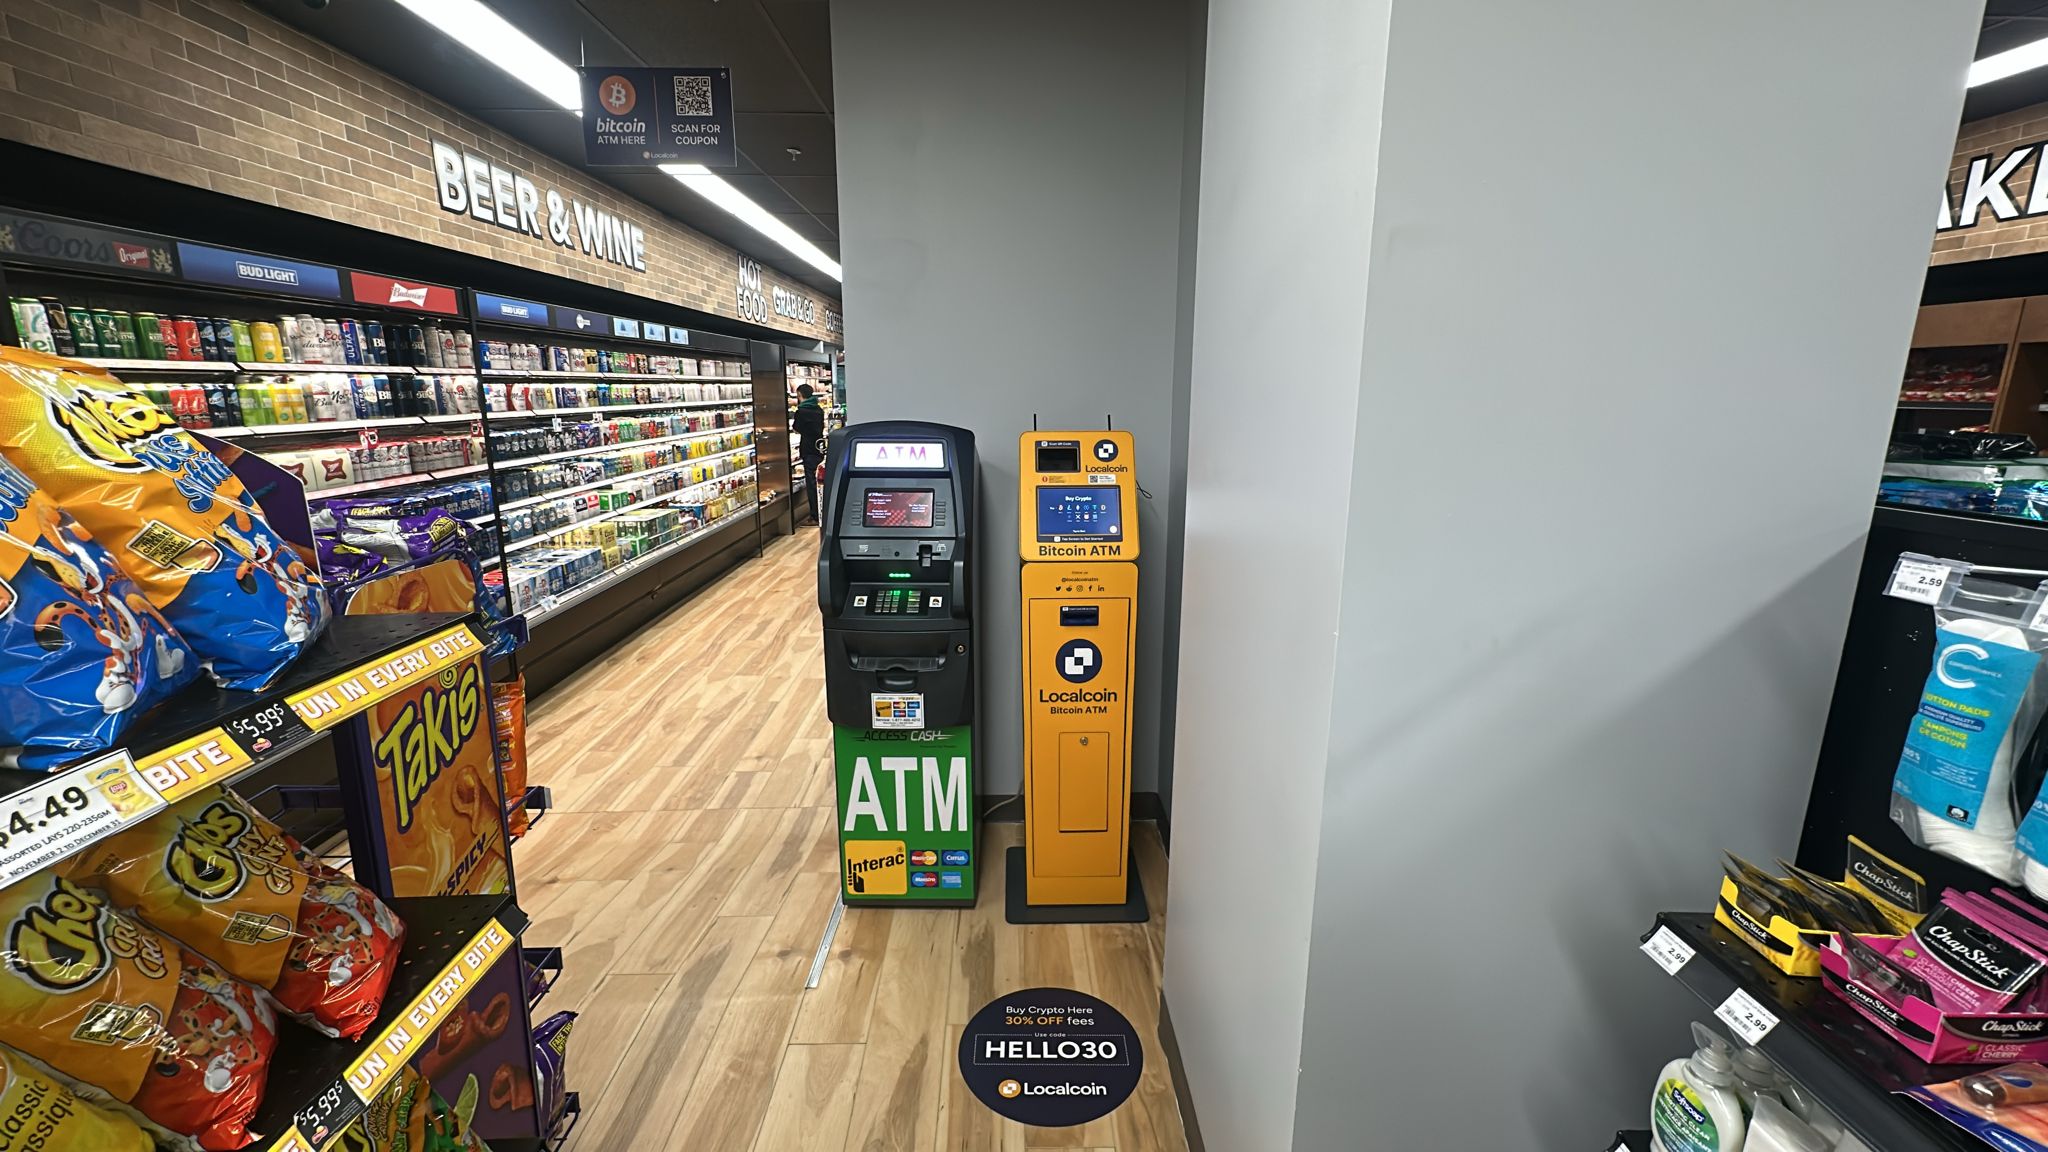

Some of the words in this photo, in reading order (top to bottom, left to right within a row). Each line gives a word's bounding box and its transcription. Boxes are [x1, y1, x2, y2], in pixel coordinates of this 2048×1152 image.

[596, 118, 646, 133] bitcoin
[671, 124, 699, 133] SCAN
[701, 124, 721, 133] FOR
[597, 136, 619, 145] ATM
[620, 136, 646, 145] HERE
[675, 136, 718, 145] COUPON
[650, 151, 679, 159] Localcoin
[431, 139, 544, 240] BEER
[545, 187, 576, 250] &
[571, 198, 646, 273] WINE
[17, 221, 111, 263] Coors
[118, 247, 148, 265] Original
[238, 266, 264, 279] BUD
[264, 269, 296, 283] LIGHT
[738, 253, 762, 292] HOT
[392, 286, 425, 300] Budweiser
[501, 305, 513, 315] BUD
[513, 307, 528, 317] LIGHT
[736, 285, 768, 324] FOOD
[772, 285, 798, 319] GRAB
[804, 298, 815, 325] GO
[876, 445, 927, 461] ATM
[1085, 465, 1128, 473] Localcoin
[1039, 546, 1086, 556] Bitcoin
[1089, 546, 1121, 556] ATM
[1918, 576, 1943, 587] 2.59
[338, 680, 369, 701] IN
[365, 650, 430, 690] EVERY
[429, 631, 473, 660] BITE
[1039, 688, 1118, 703] Localcoin
[1050, 706, 1083, 715] Bitcoin
[1085, 706, 1107, 714] ATM
[1959, 704, 1991, 717] PADS
[864, 731, 908, 741] ACCESS
[910, 731, 942, 741] CASH
[1931, 732, 1967, 749] COTON
[378, 662, 480, 829] Takis
[151, 741, 231, 792] BITE
[844, 757, 968, 832] ATM
[0, 842, 43, 867] ASSORTED
[42, 831, 65, 846] LAYS
[63, 809, 112, 836] 220-235GM
[9, 850, 56, 878] NOVEMBER
[56, 848, 64, 856] 2
[74, 825, 112, 846] DECEMBER
[111, 819, 122, 830] 31
[447, 832, 487, 889] SPICY
[848, 853, 905, 878] Interac
[1853, 861, 1914, 902] ChapStick
[1731, 909, 1768, 941] ChapStick
[1668, 947, 1686, 964] 2.99
[1928, 925, 2009, 979] ChapStick
[1920, 958, 1949, 979] CLASSIC
[1950, 977, 1980, 998] CHERRY
[345, 1053, 388, 1090] UN
[384, 1027, 413, 1056] IN
[408, 965, 467, 1029] EVERY
[463, 928, 504, 970] BITE
[1006, 1006, 1026, 1015] Buy
[1028, 1006, 1065, 1015] Crypto
[1067, 1006, 1093, 1014] Here
[1845, 984, 1901, 1022] ChapStick
[1005, 1016, 1034, 1025] 30%
[1037, 1016, 1063, 1025] OFF
[1067, 1017, 1094, 1026] fees
[1744, 1012, 1767, 1031] 2.99
[1982, 1020, 2044, 1033] ChapStick
[985, 1041, 1117, 1059] HELLO30
[1984, 1044, 2026, 1052] CLASSIC
[1024, 1082, 1107, 1096] Localcoin
[1673, 1089, 1705, 1123] Softsoap
[1688, 1120, 1711, 1141] CLEAN
